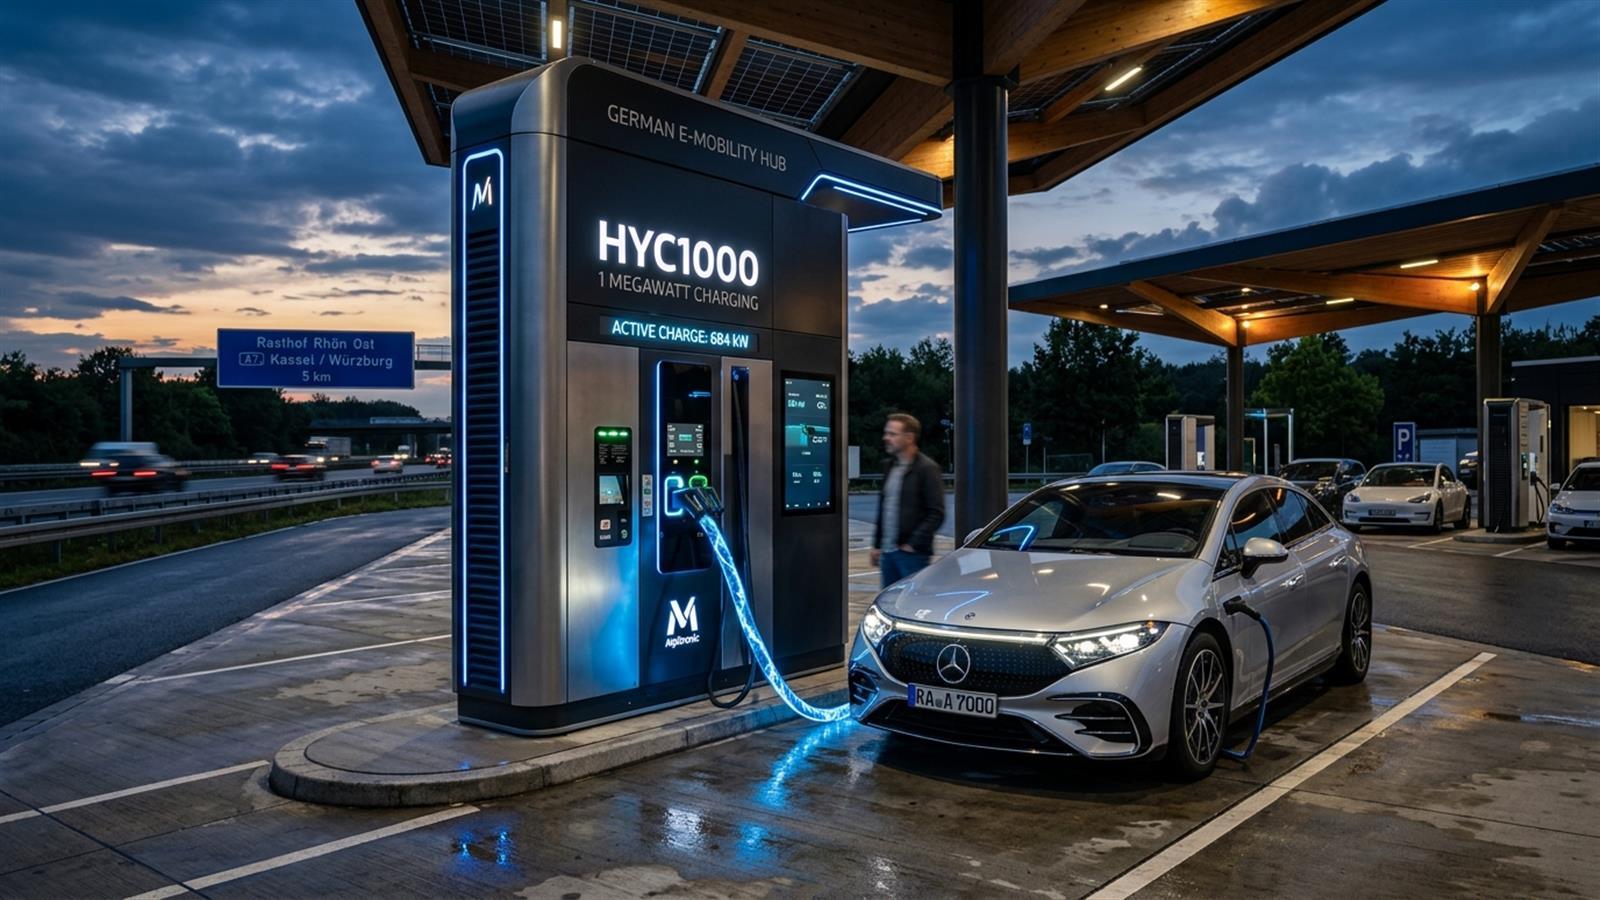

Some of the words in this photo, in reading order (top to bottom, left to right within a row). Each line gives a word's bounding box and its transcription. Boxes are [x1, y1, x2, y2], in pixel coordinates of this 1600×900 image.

[607, 104, 675, 139] GERMAN
[679, 125, 757, 162] E-MOBILITY
[761, 149, 787, 172] HUB
[598, 219, 760, 288] HYC1000
[598, 271, 605, 288] 1
[609, 273, 691, 300] MEGAWATT
[694, 286, 760, 311] CHARGING
[256, 336, 308, 349] Rasthof
[313, 337, 347, 350] Rhön
[352, 338, 375, 350] Ost
[611, 319, 657, 339] ACTIVE
[658, 325, 708, 344] CHARGE:
[709, 331, 732, 347] 684
[270, 353, 315, 366] Kassel
[319, 353, 326, 366] /
[329, 353, 394, 370] Würzburg
[301, 371, 310, 383] 5
[313, 371, 332, 383] km
[1397, 428, 1411, 451] P
[916, 688, 934, 707] RA
[943, 692, 953, 710] A
